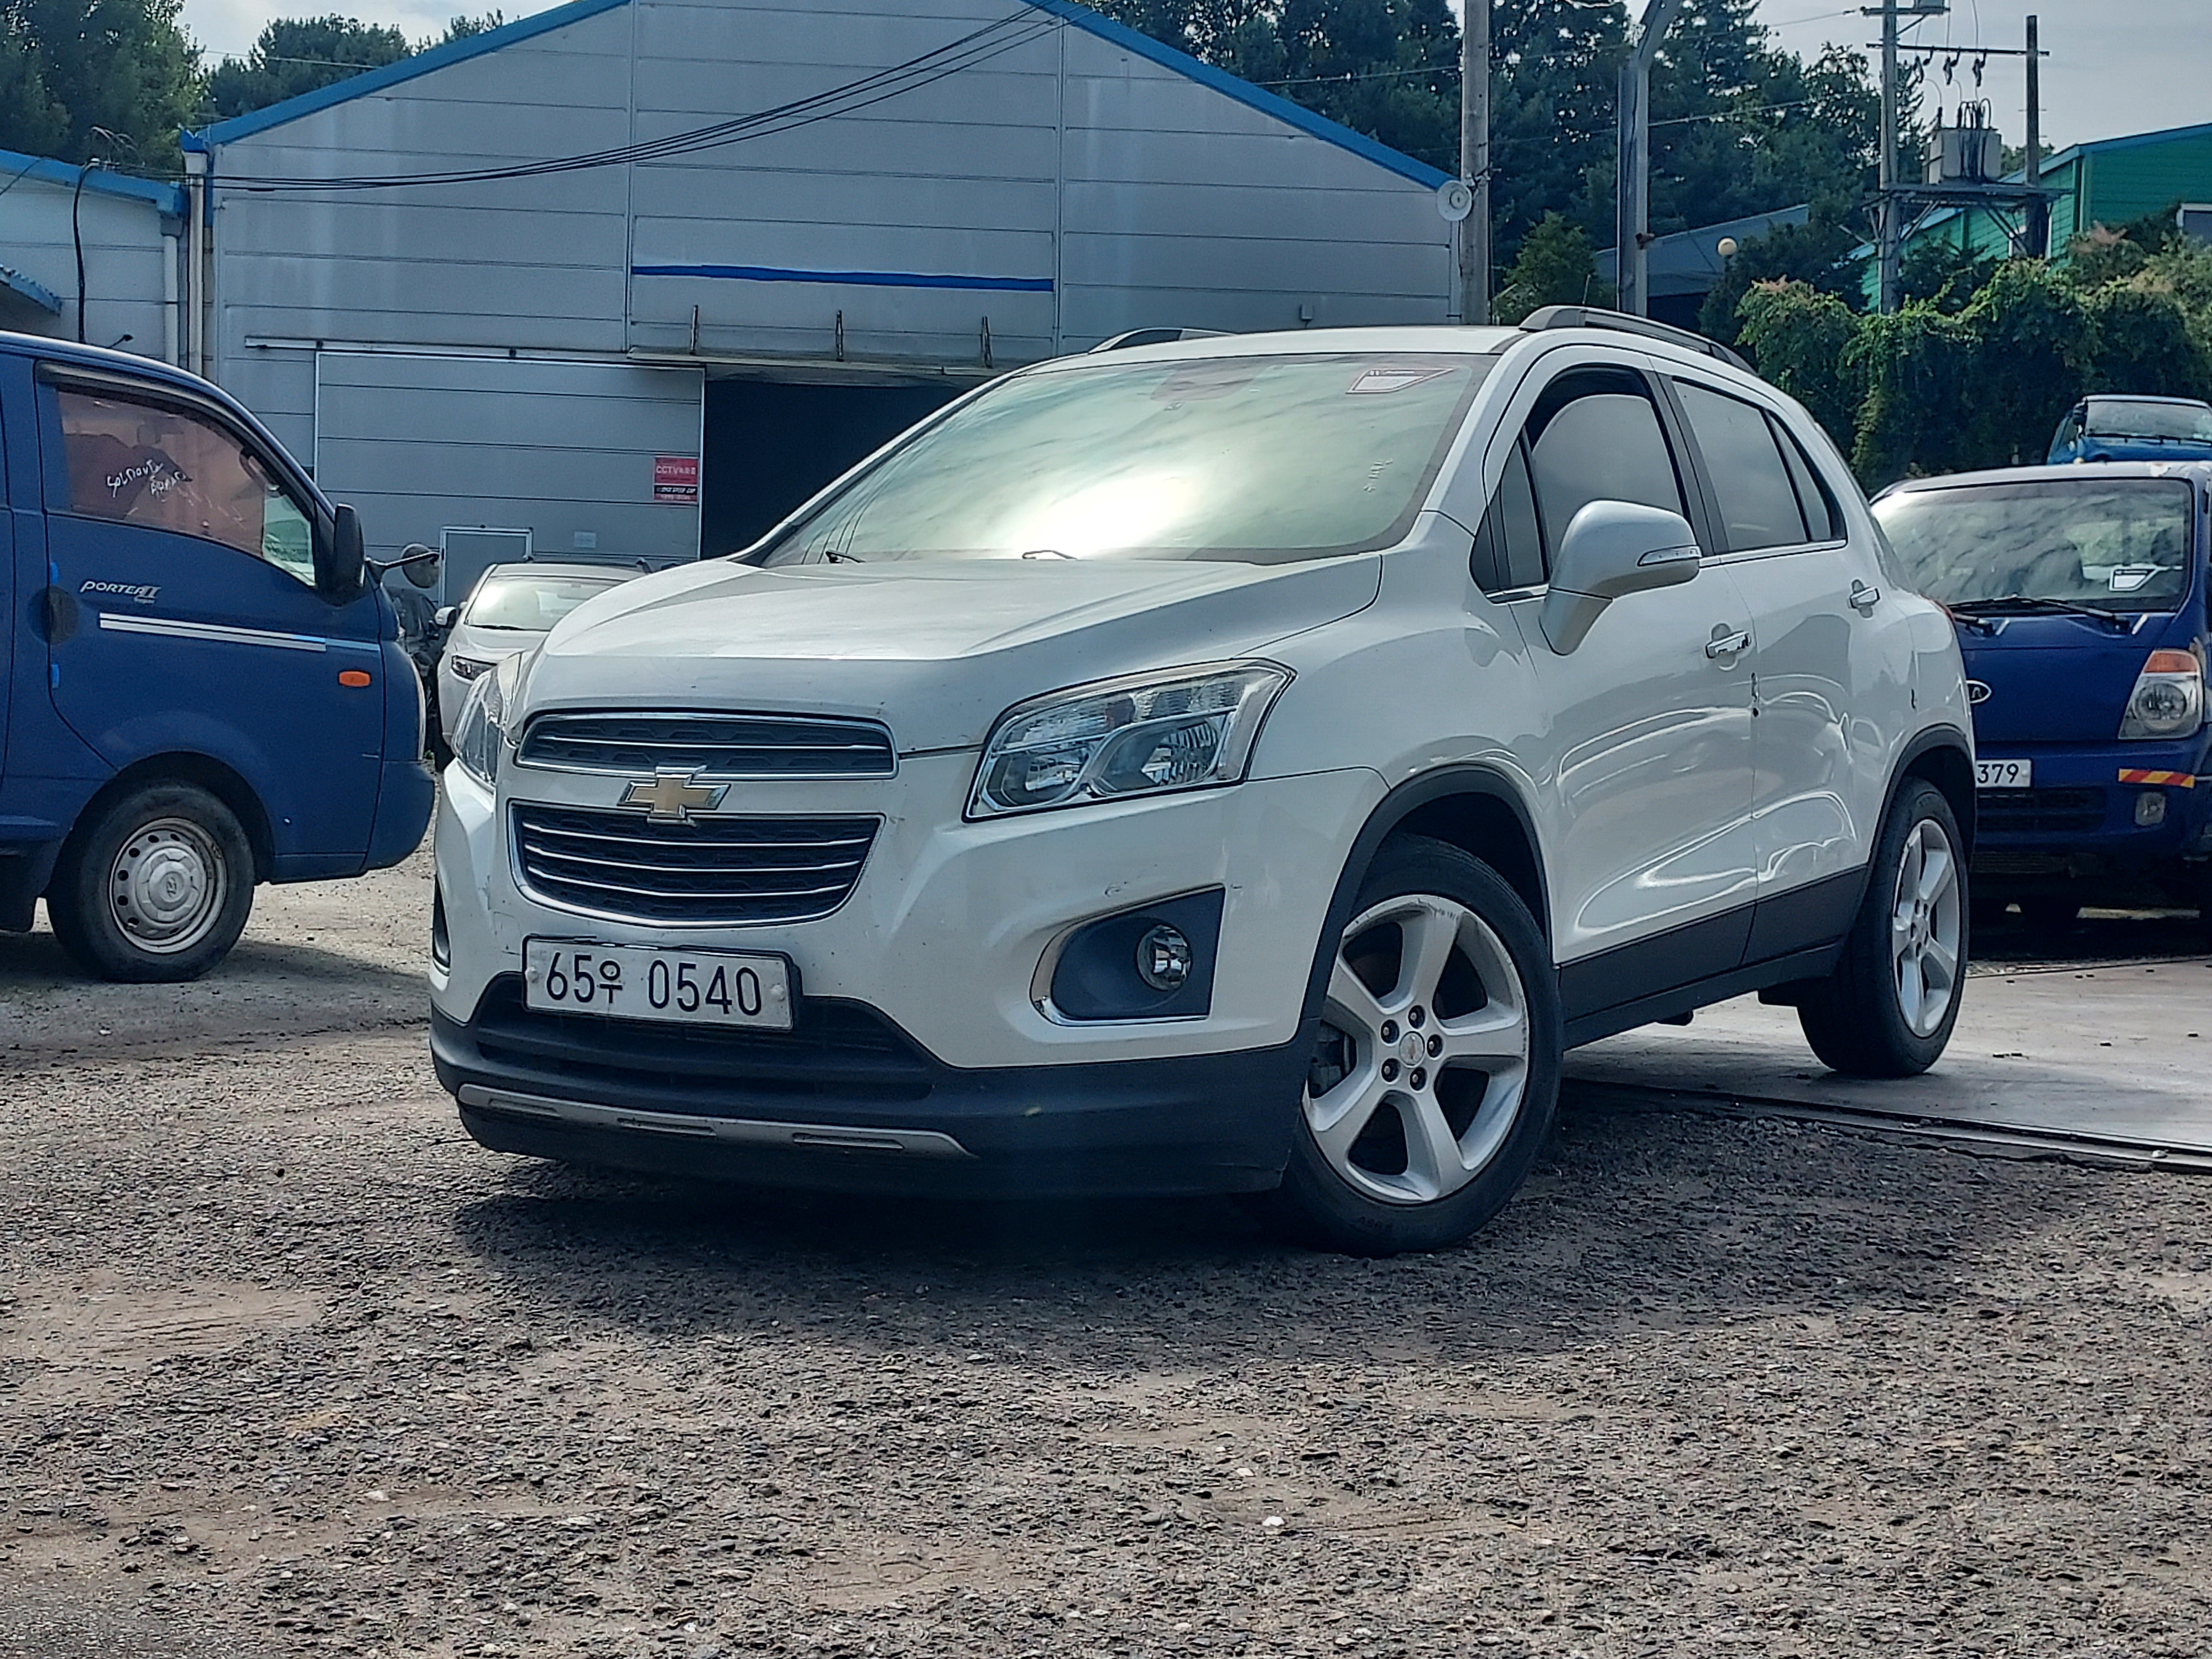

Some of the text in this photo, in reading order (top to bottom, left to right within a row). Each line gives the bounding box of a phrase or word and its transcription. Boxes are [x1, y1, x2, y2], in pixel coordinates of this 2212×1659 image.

[1978, 763, 2019, 784] 379
[546, 952, 762, 1016] 65우 0540
